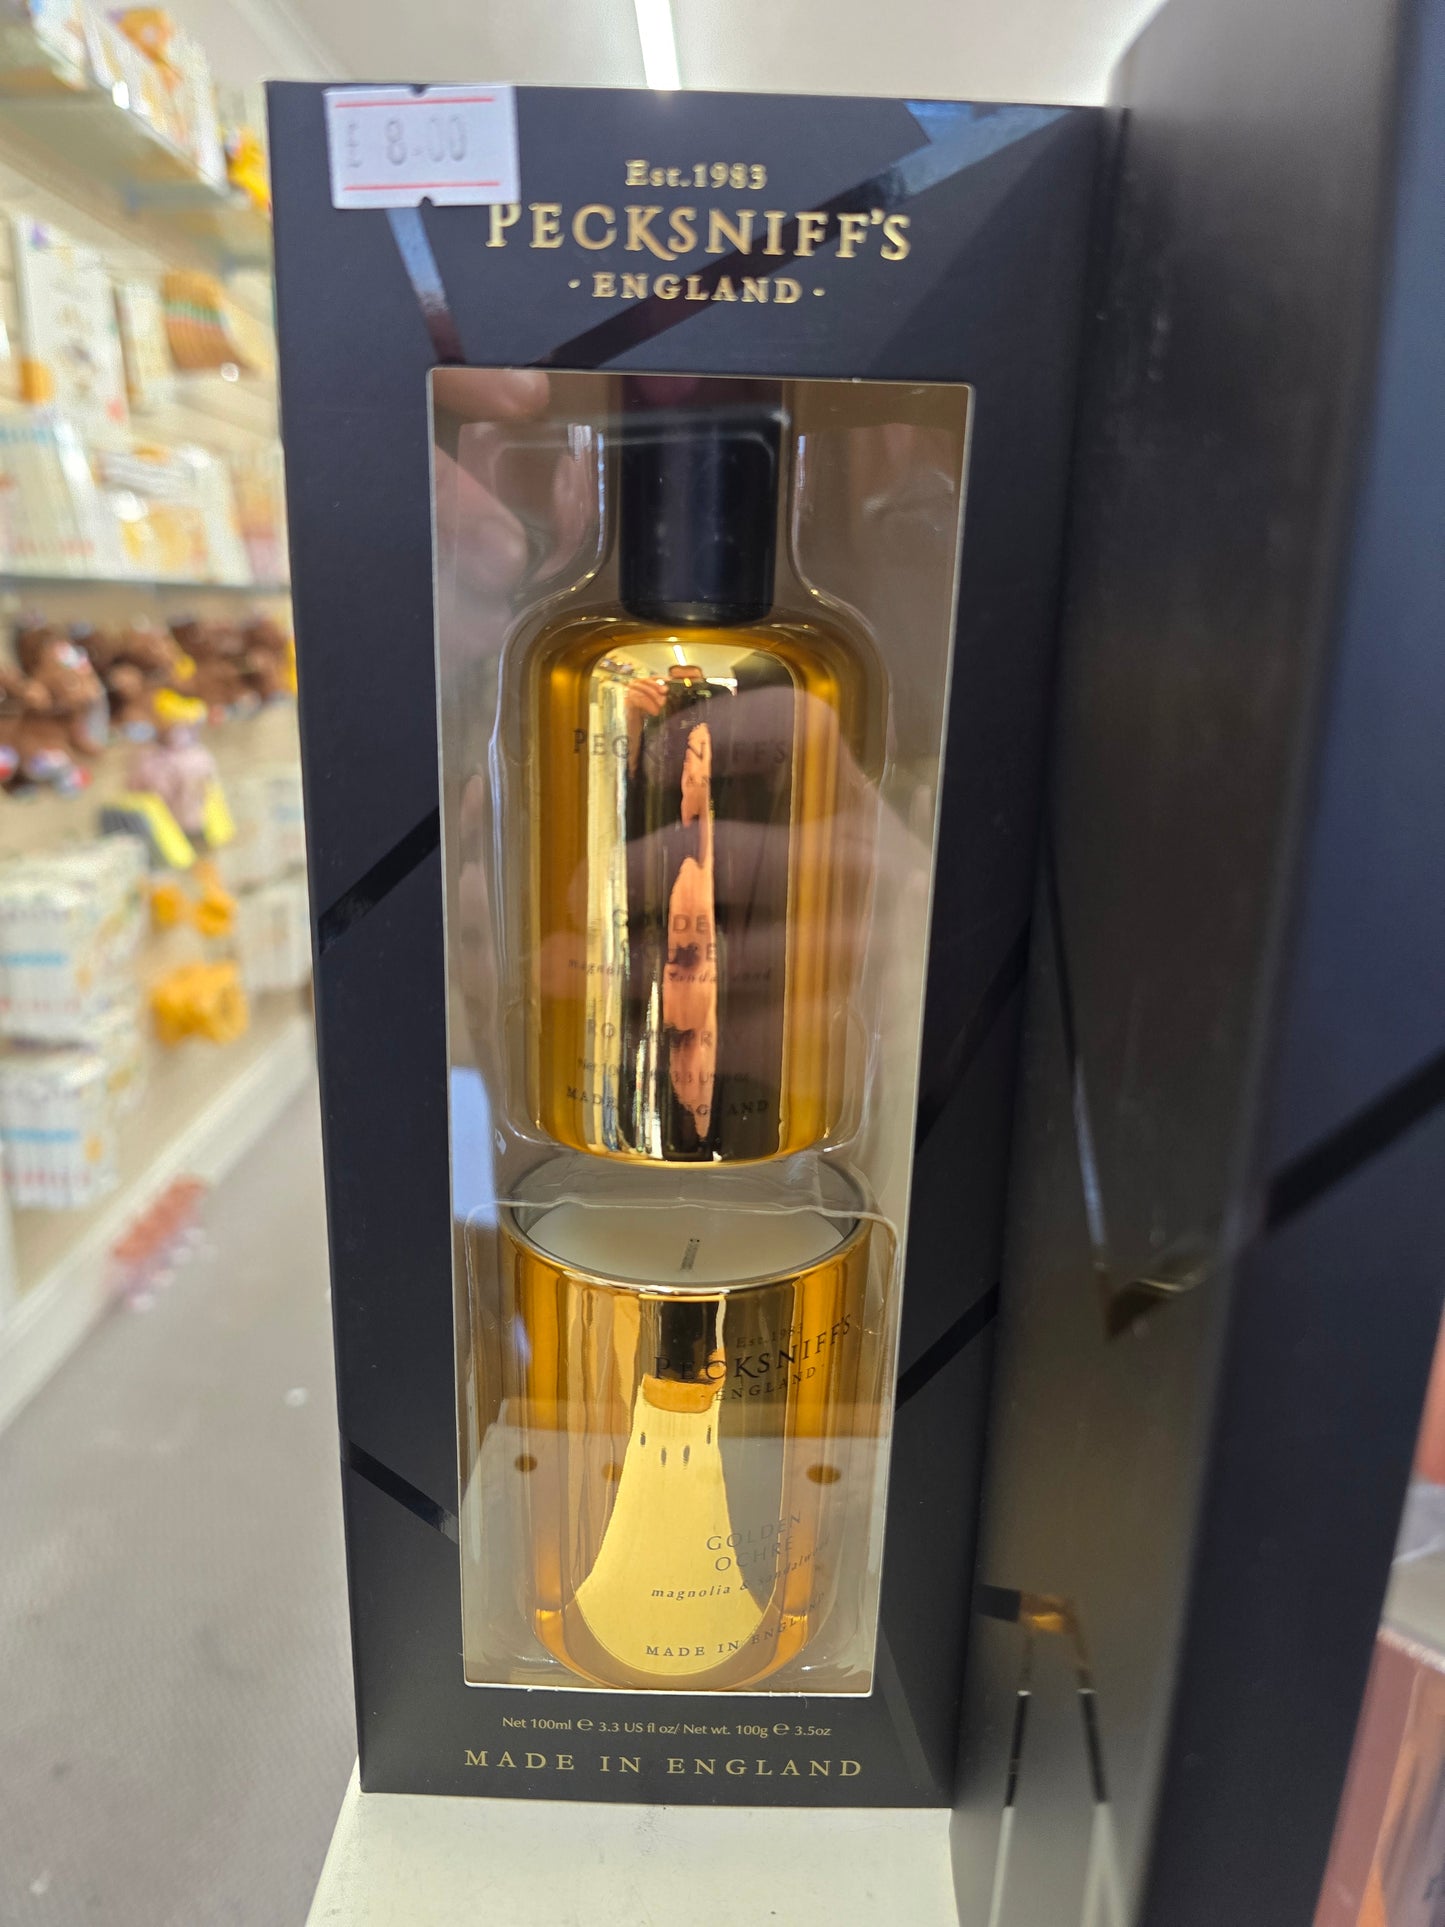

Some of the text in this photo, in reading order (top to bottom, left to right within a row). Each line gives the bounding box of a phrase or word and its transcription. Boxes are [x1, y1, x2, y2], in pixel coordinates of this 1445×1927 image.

[625, 159, 768, 190] Est.1983
[485, 203, 911, 261] PECKSNIFF'S
[591, 271, 803, 304] ENGLAND
[654, 1314, 851, 1380] PECKSNIFF'S
[715, 1366, 817, 1401] ENGLAND
[706, 1511, 801, 1551] GOLDEN
[651, 1585, 731, 1601] magnolia
[646, 1645, 705, 1658] MADE
[717, 1640, 741, 1654] IN
[502, 1717, 527, 1729] Net
[531, 1718, 573, 1731] 100ml
[598, 1722, 620, 1733] 3.3
[624, 1722, 643, 1733] US
[647, 1722, 656, 1734] fl
[683, 1723, 708, 1735] Net
[711, 1724, 732, 1736] wt.
[735, 1725, 769, 1738] 100g
[794, 1725, 833, 1737] 3.5oz
[463, 1749, 862, 1777] MADE IN ENGLAND
